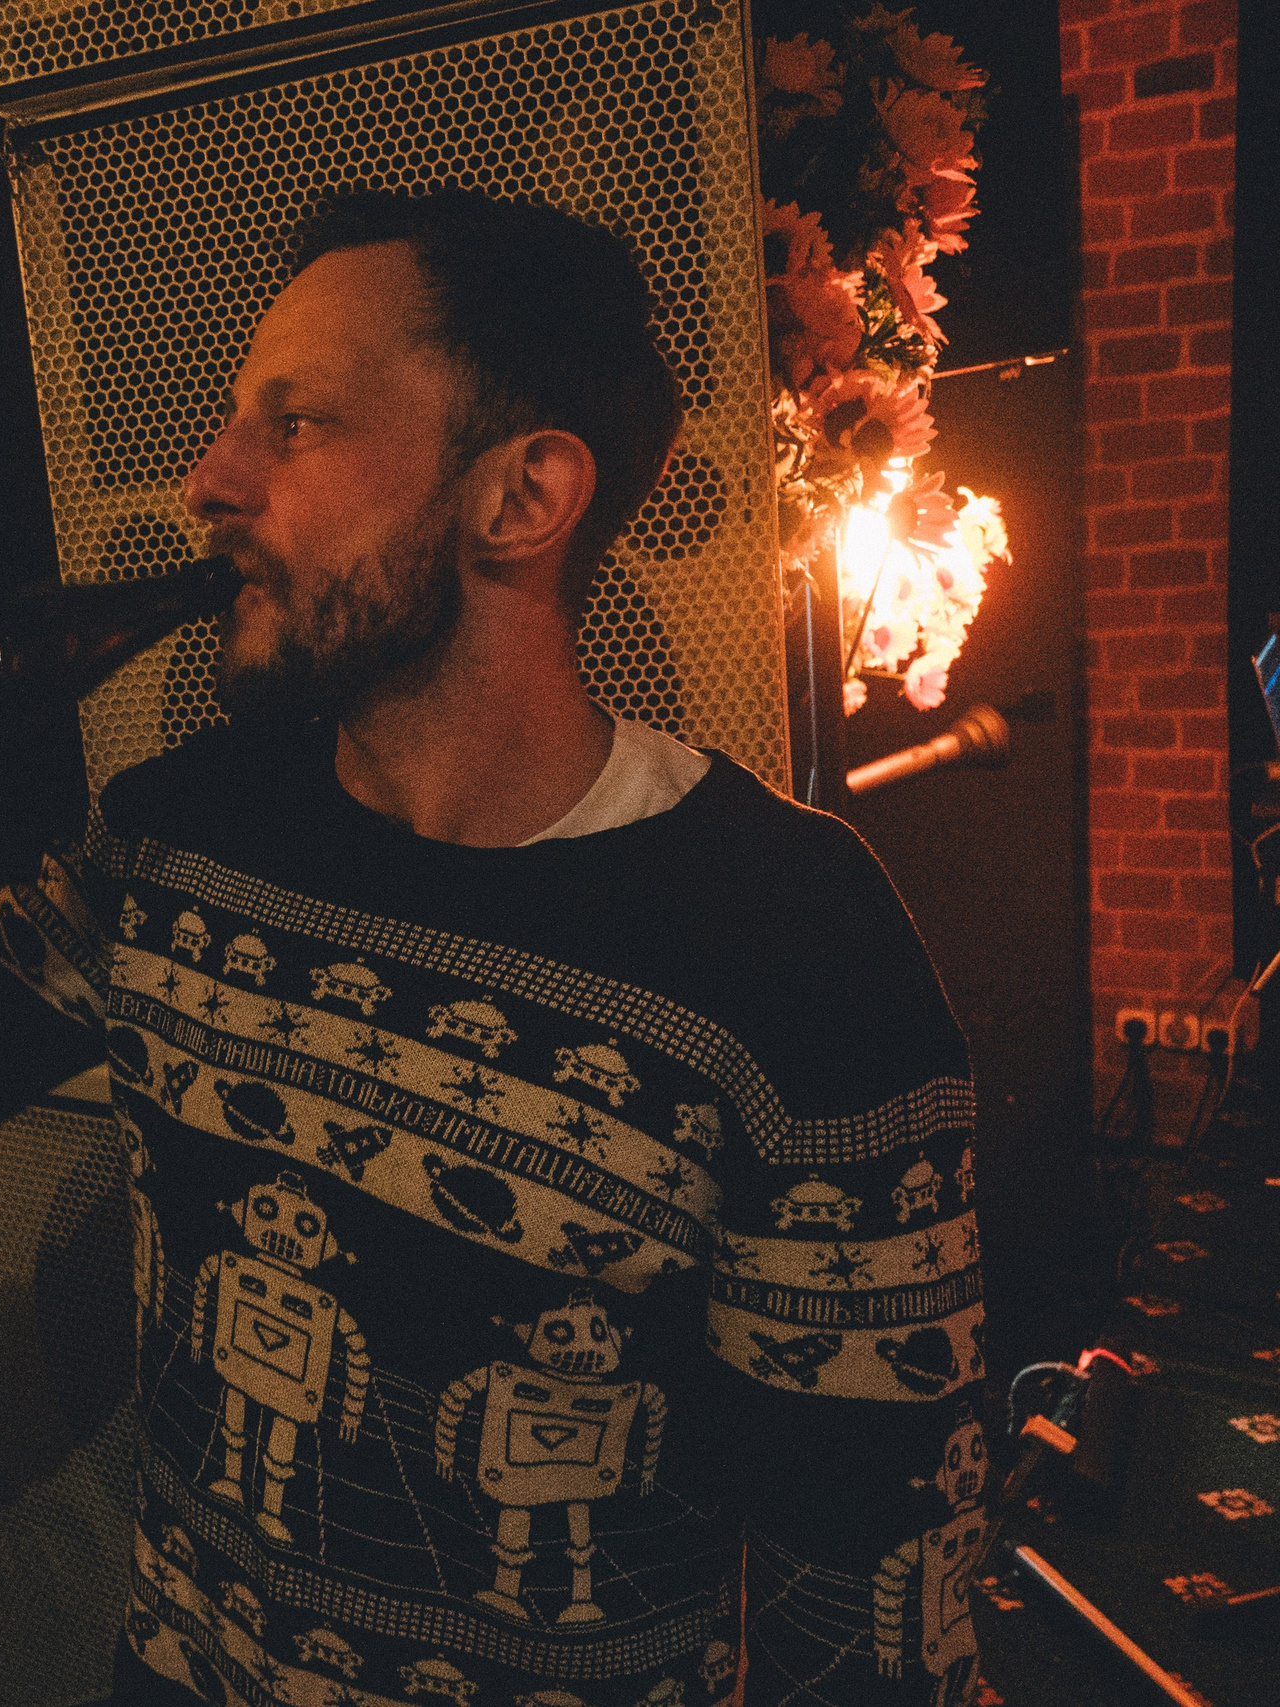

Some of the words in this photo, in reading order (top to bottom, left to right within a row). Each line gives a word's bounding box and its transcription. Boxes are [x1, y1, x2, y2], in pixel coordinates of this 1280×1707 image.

[173, 1016, 210, 1056] ЛИШЬ
[214, 1036, 317, 1088] МАШИНА
[327, 1067, 425, 1127] ТОЛЬКО
[429, 1109, 606, 1200] ИМИТАЦИЯ
[605, 1183, 692, 1246] ЖИЗНИ
[761, 1289, 851, 1323] ЛИШЬ
